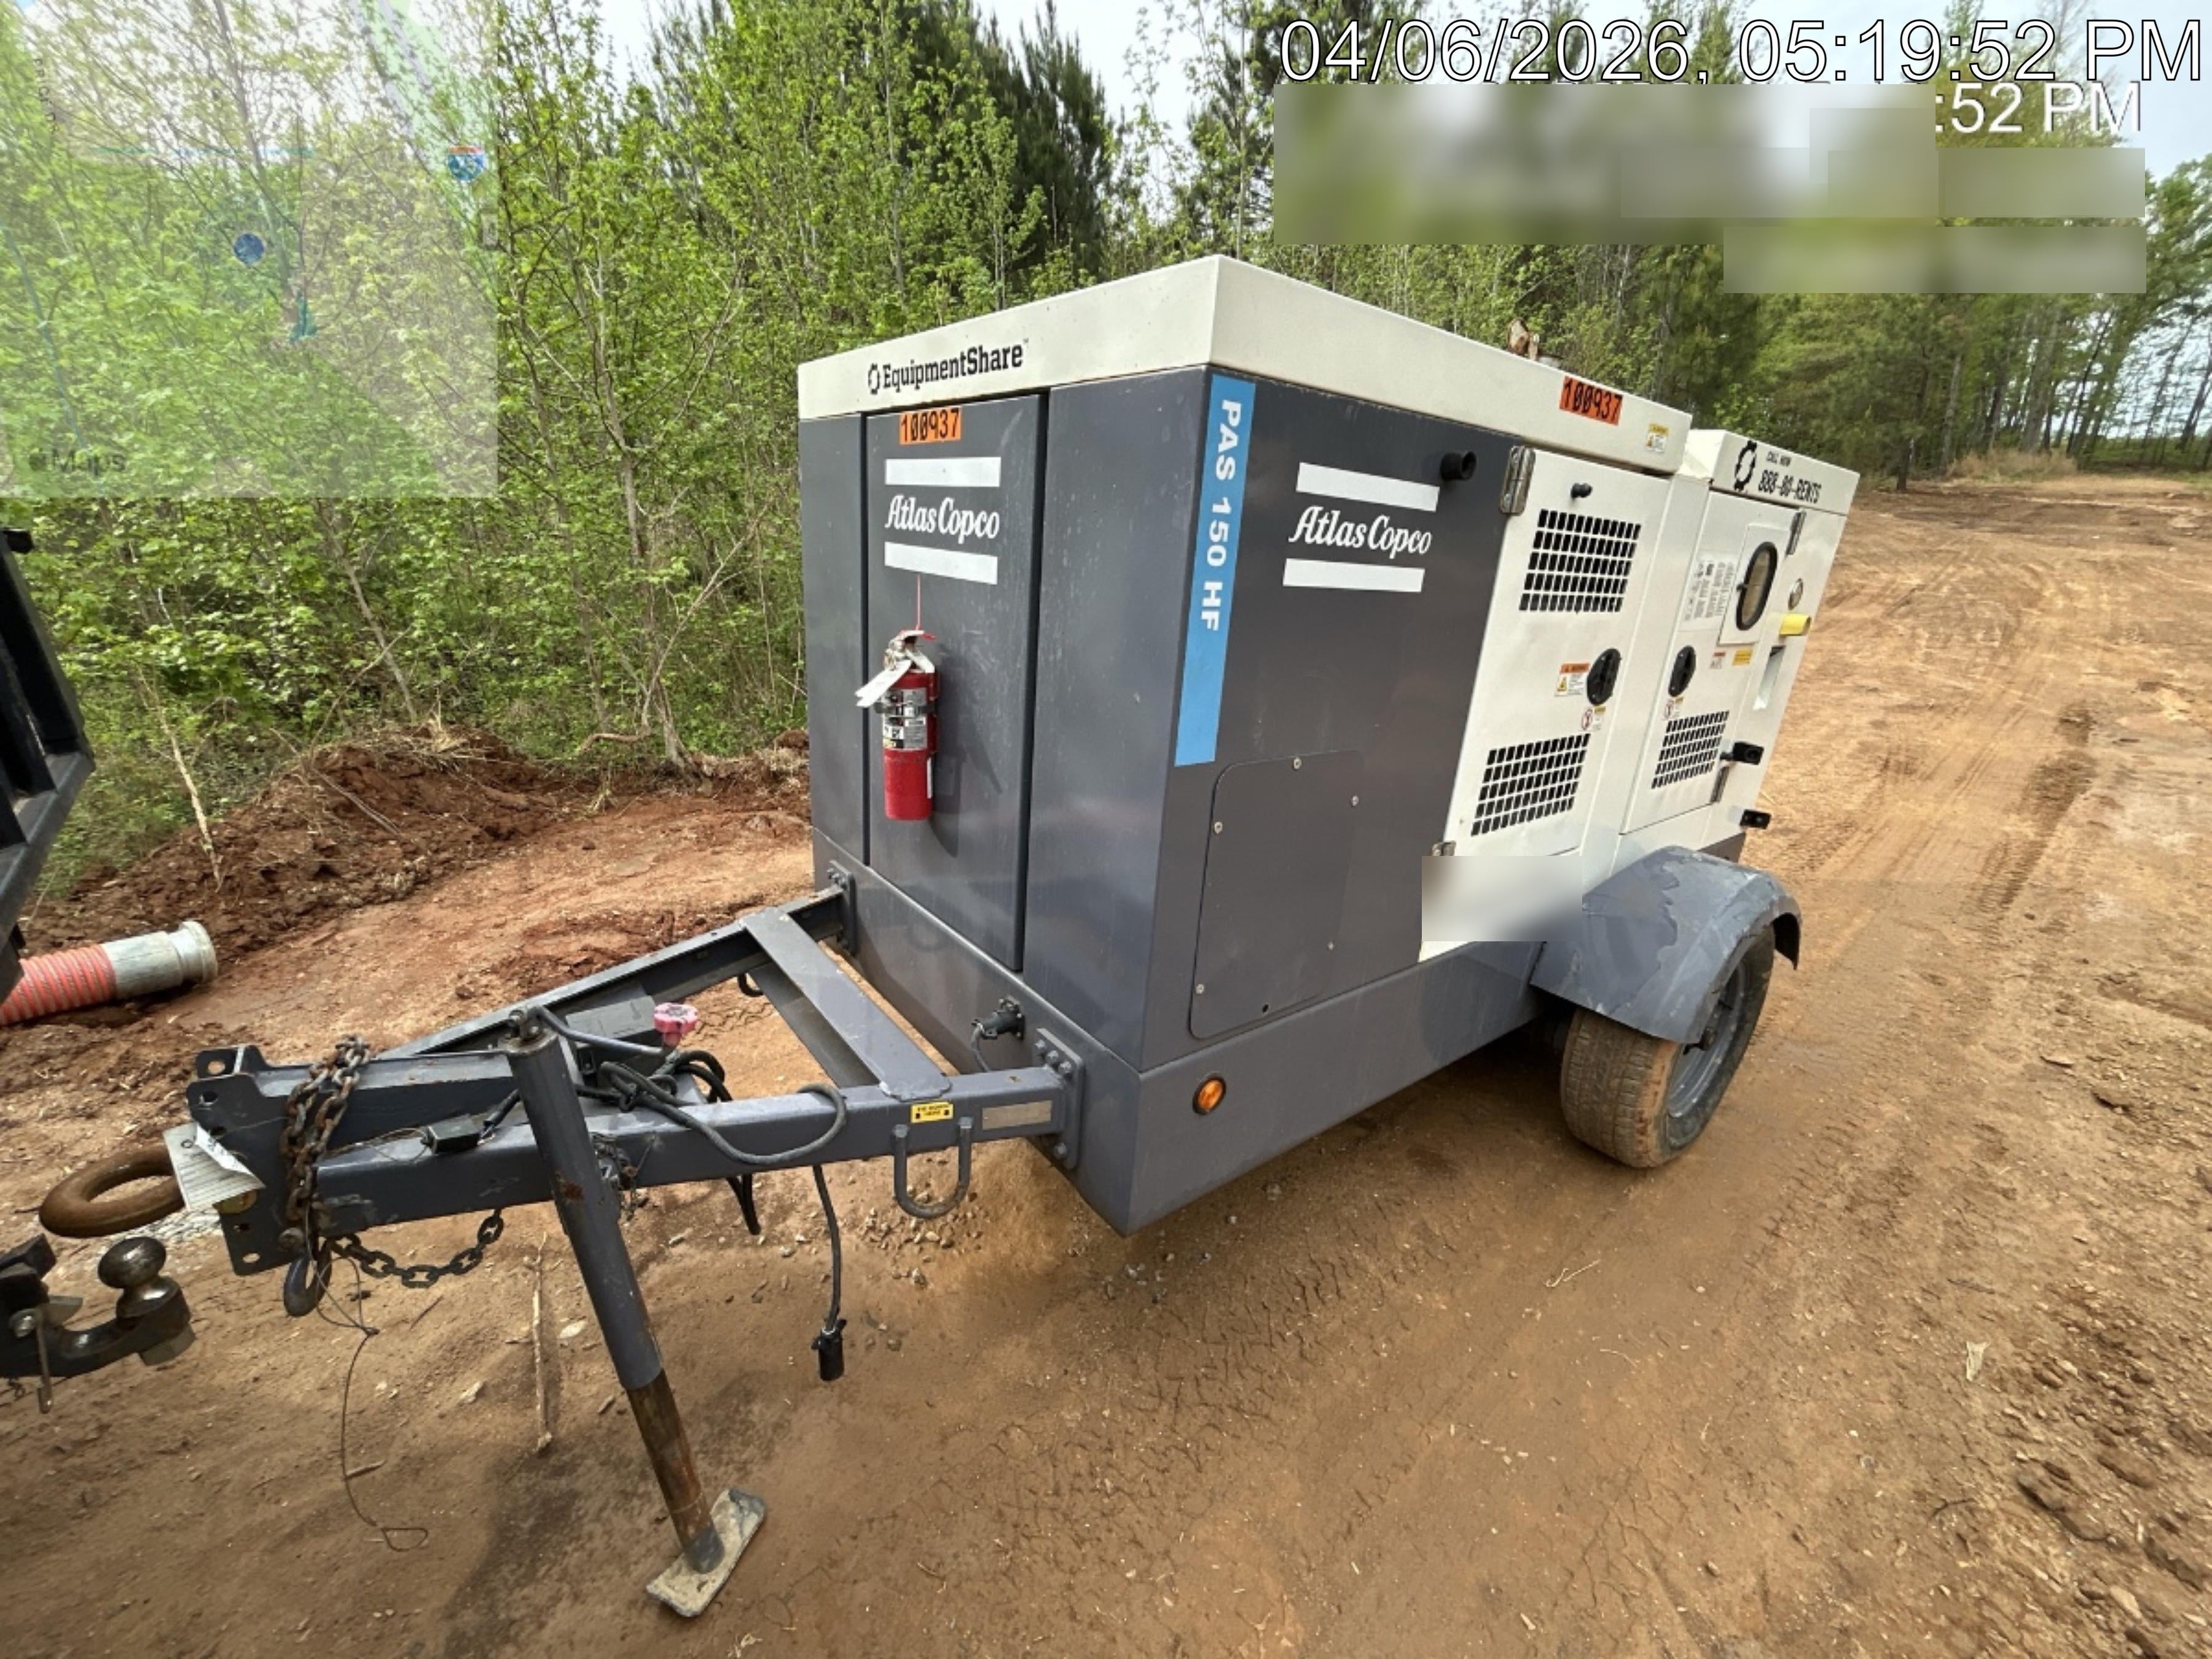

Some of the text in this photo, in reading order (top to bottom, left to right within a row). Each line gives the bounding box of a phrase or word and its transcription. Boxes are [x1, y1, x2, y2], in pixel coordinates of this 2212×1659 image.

[883, 344, 1023, 393] EquipmentShare
[901, 407, 959, 442] 100937
[1564, 378, 1623, 422] 100937
[885, 494, 1000, 544] Atlas Copco
[1201, 399, 1242, 632] PAS 150 HF
[1288, 504, 1433, 559] Atlas Copco
